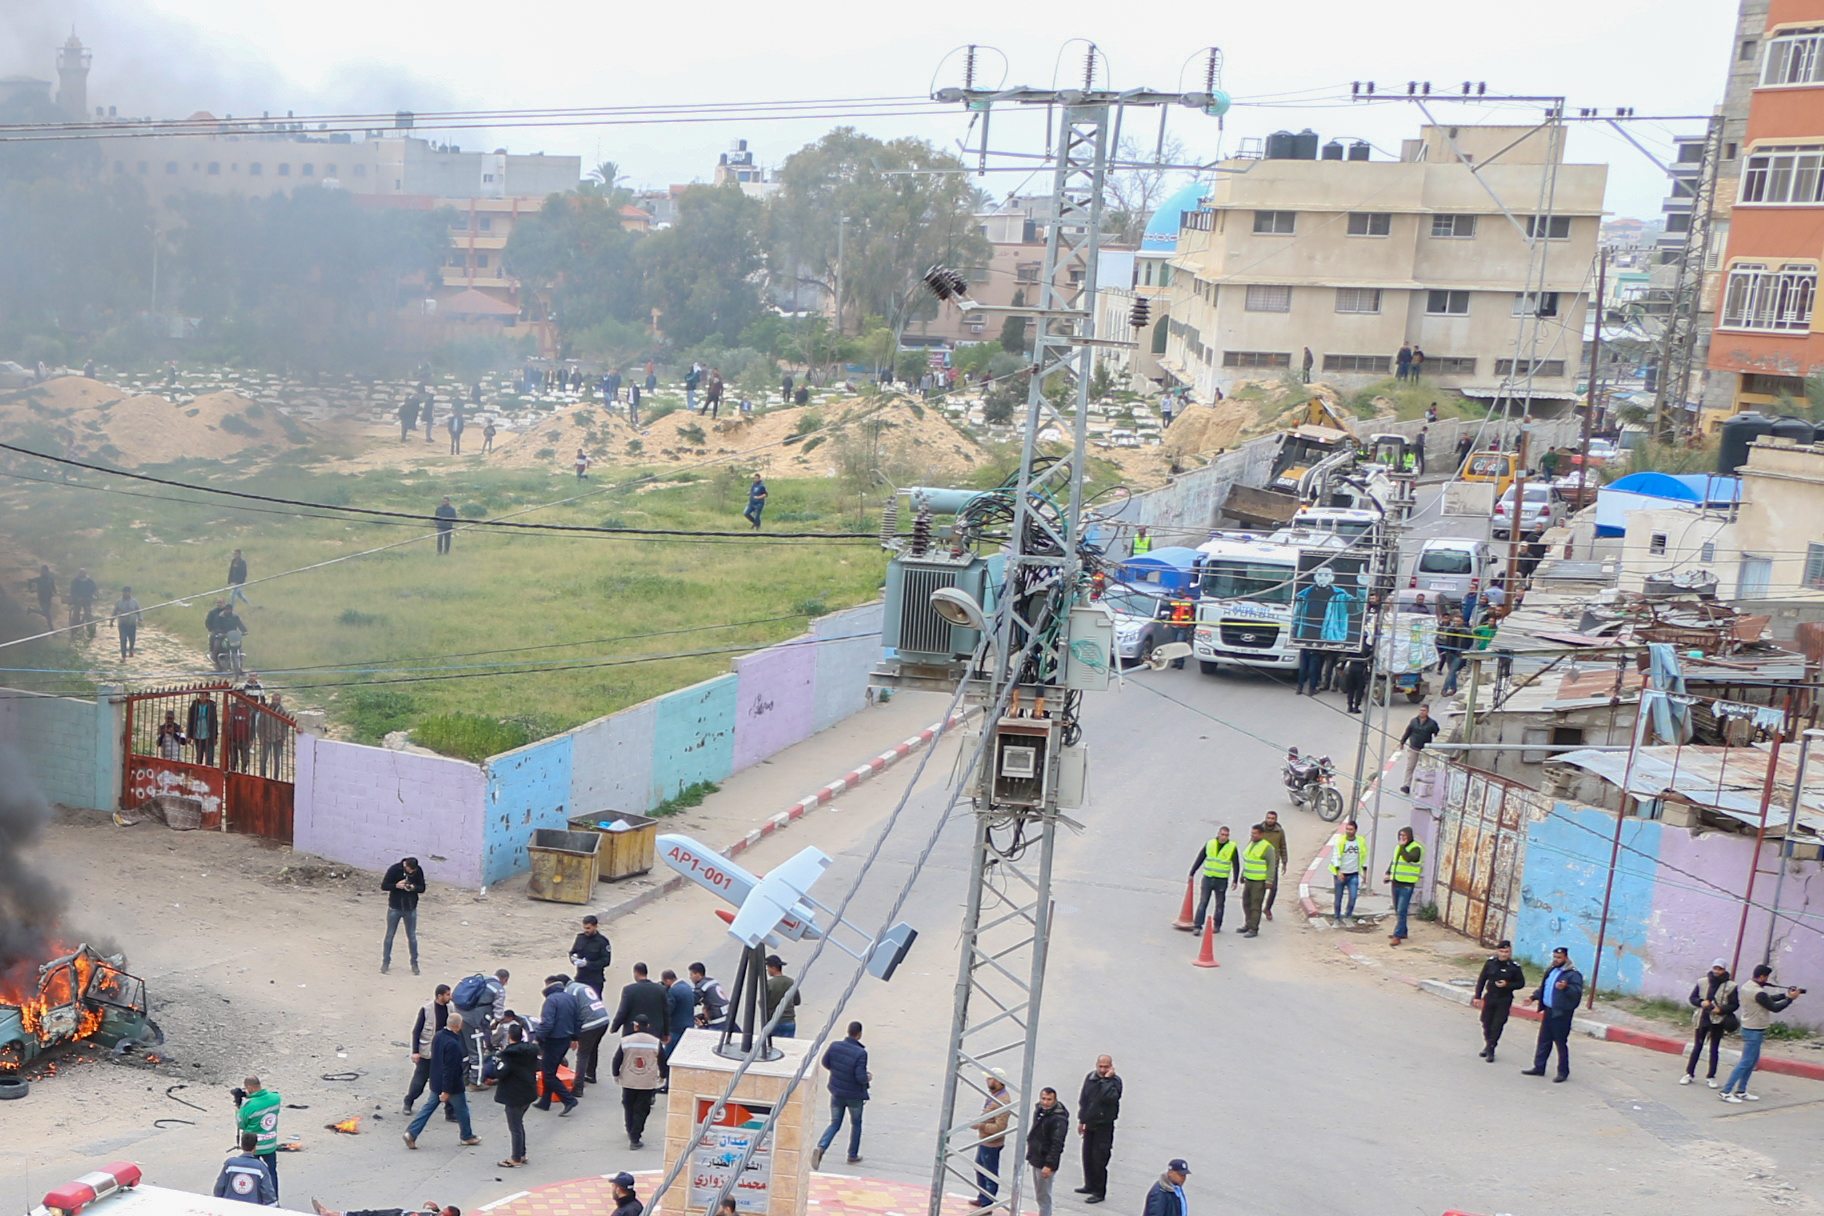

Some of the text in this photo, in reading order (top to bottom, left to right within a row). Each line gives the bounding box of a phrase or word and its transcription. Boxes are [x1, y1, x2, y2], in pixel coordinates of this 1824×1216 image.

[1343, 844, 1359, 854] Lee
[667, 845, 734, 891] AP1-001
[737, 1176, 767, 1190] محمد
